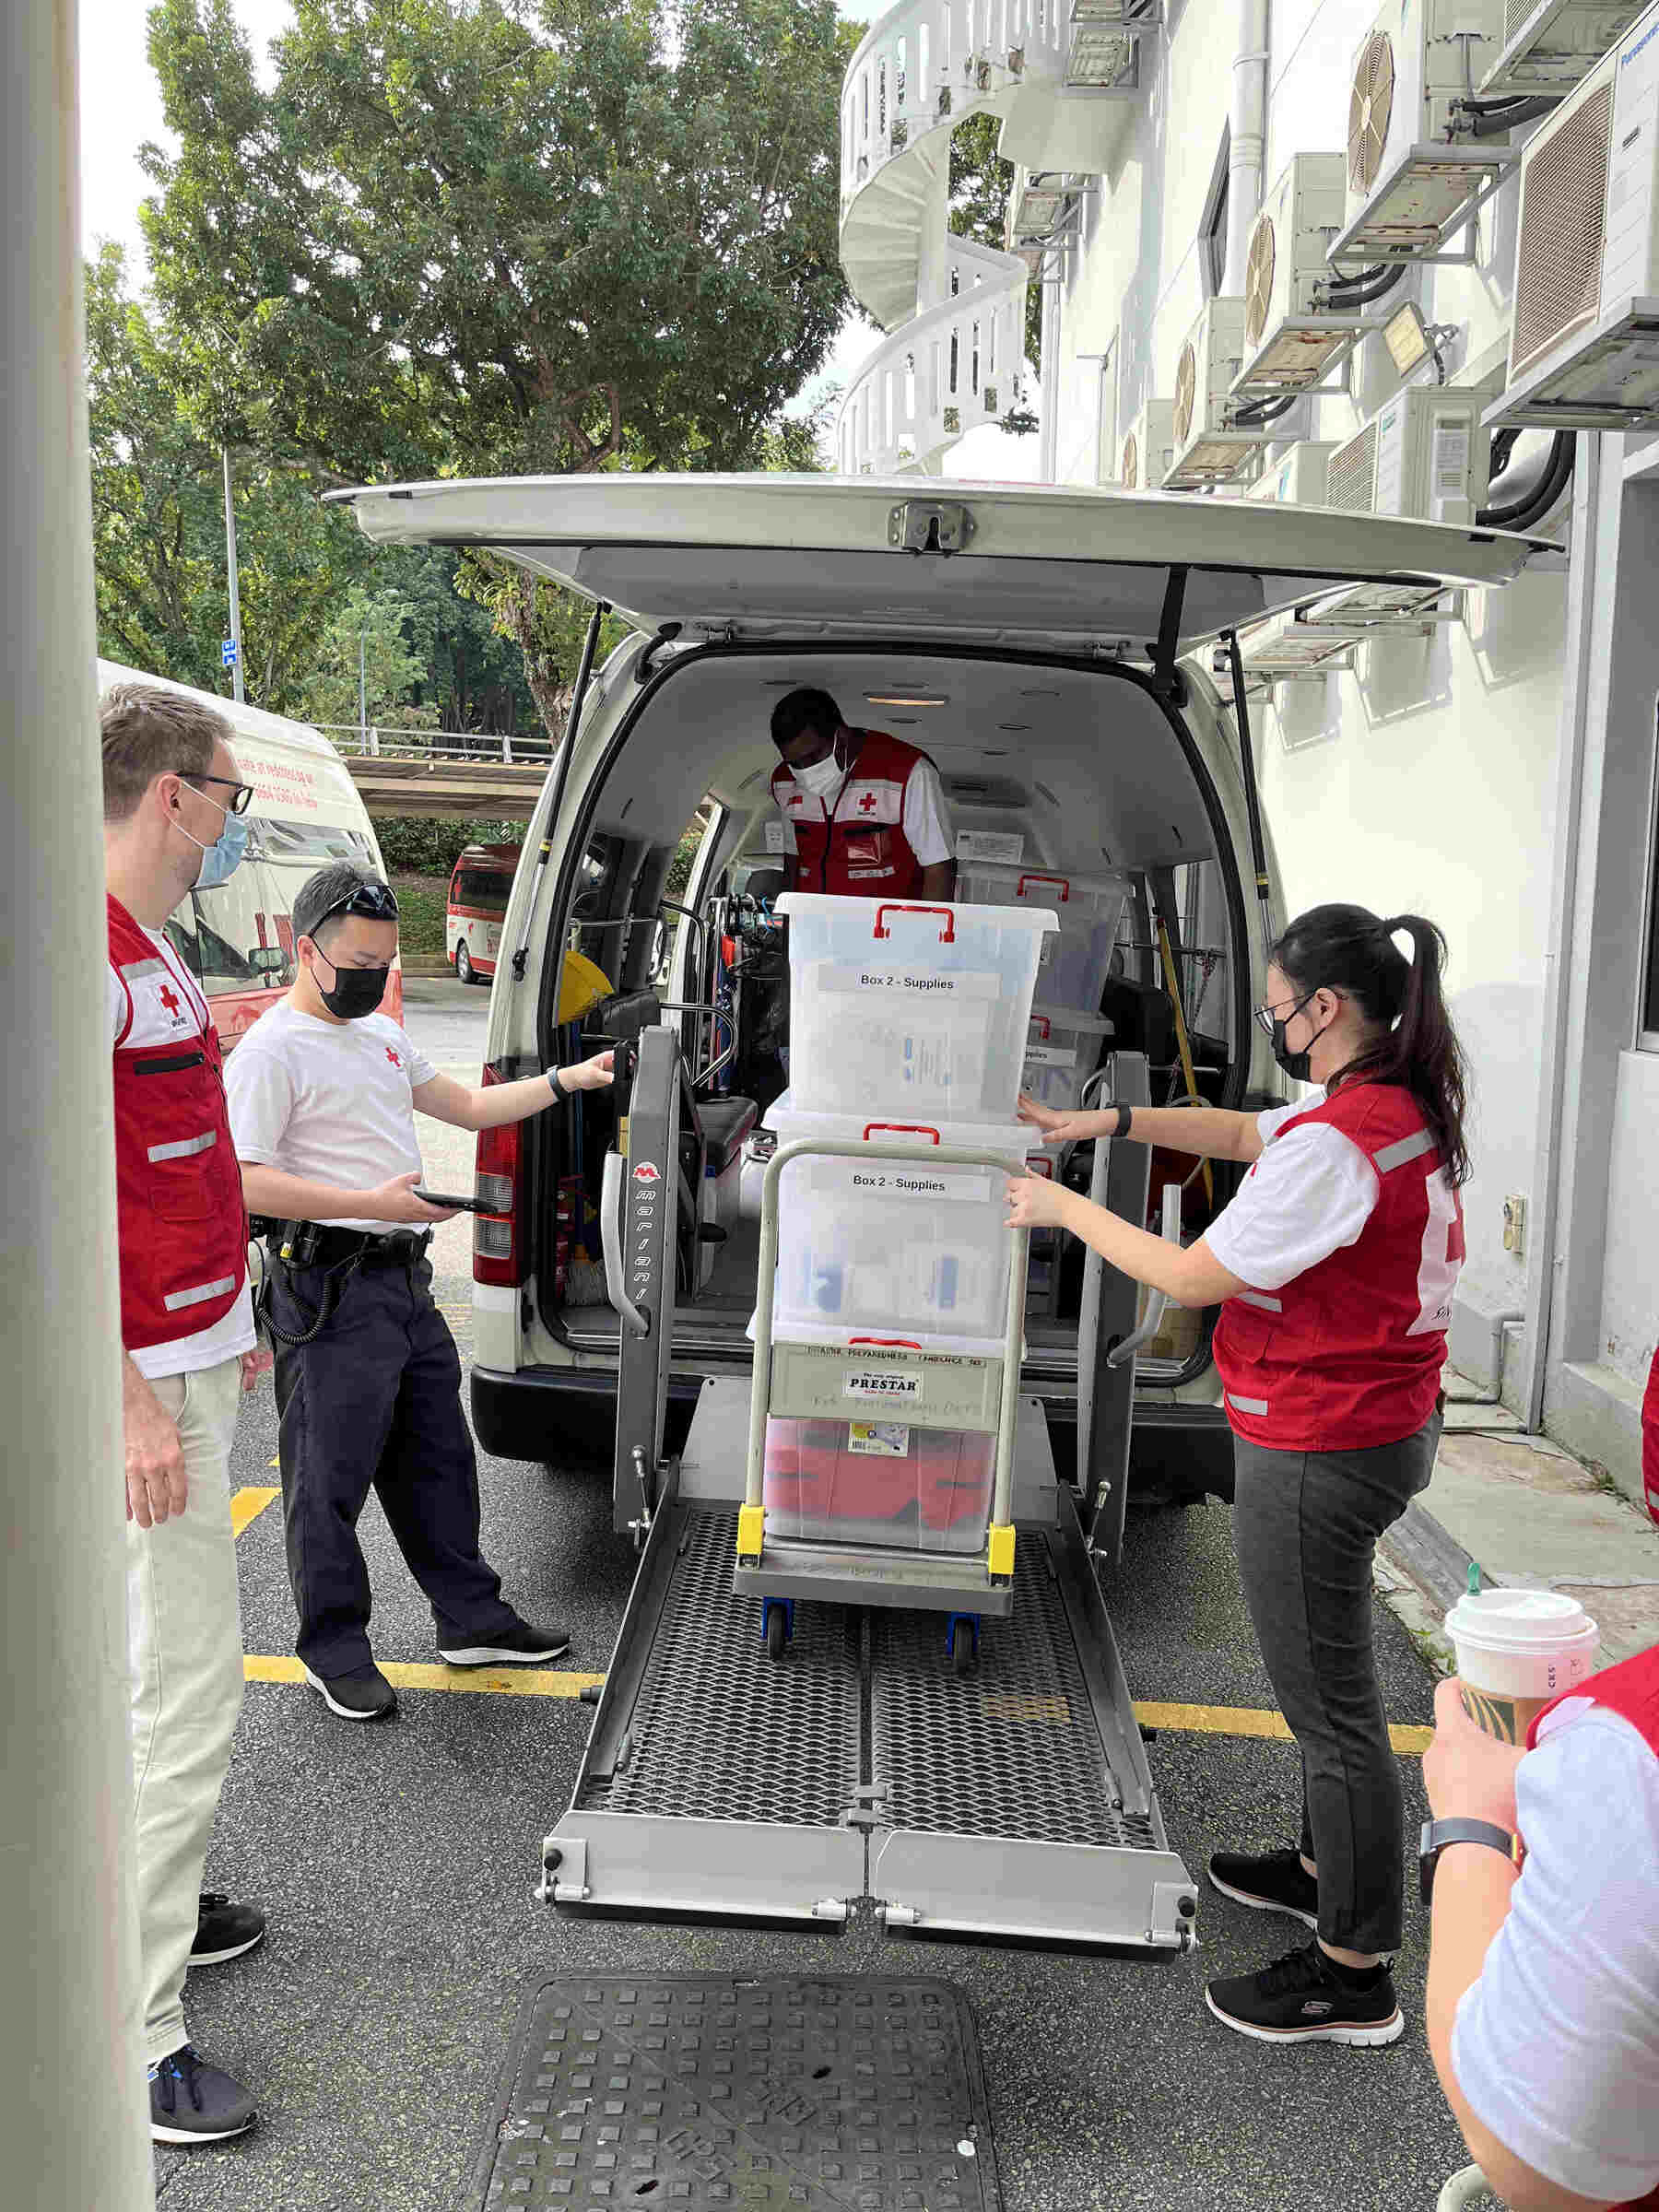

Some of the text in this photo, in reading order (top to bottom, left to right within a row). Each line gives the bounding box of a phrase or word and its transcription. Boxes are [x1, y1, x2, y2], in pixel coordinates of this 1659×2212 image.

[861, 974, 884, 986] Box
[887, 976, 894, 986] 2
[904, 976, 954, 991] Supplies
[853, 1174, 877, 1186] Box
[877, 1176, 886, 1187] 2
[895, 1177, 946, 1192] Supplies
[850, 1378, 916, 1393] PRESTAR
